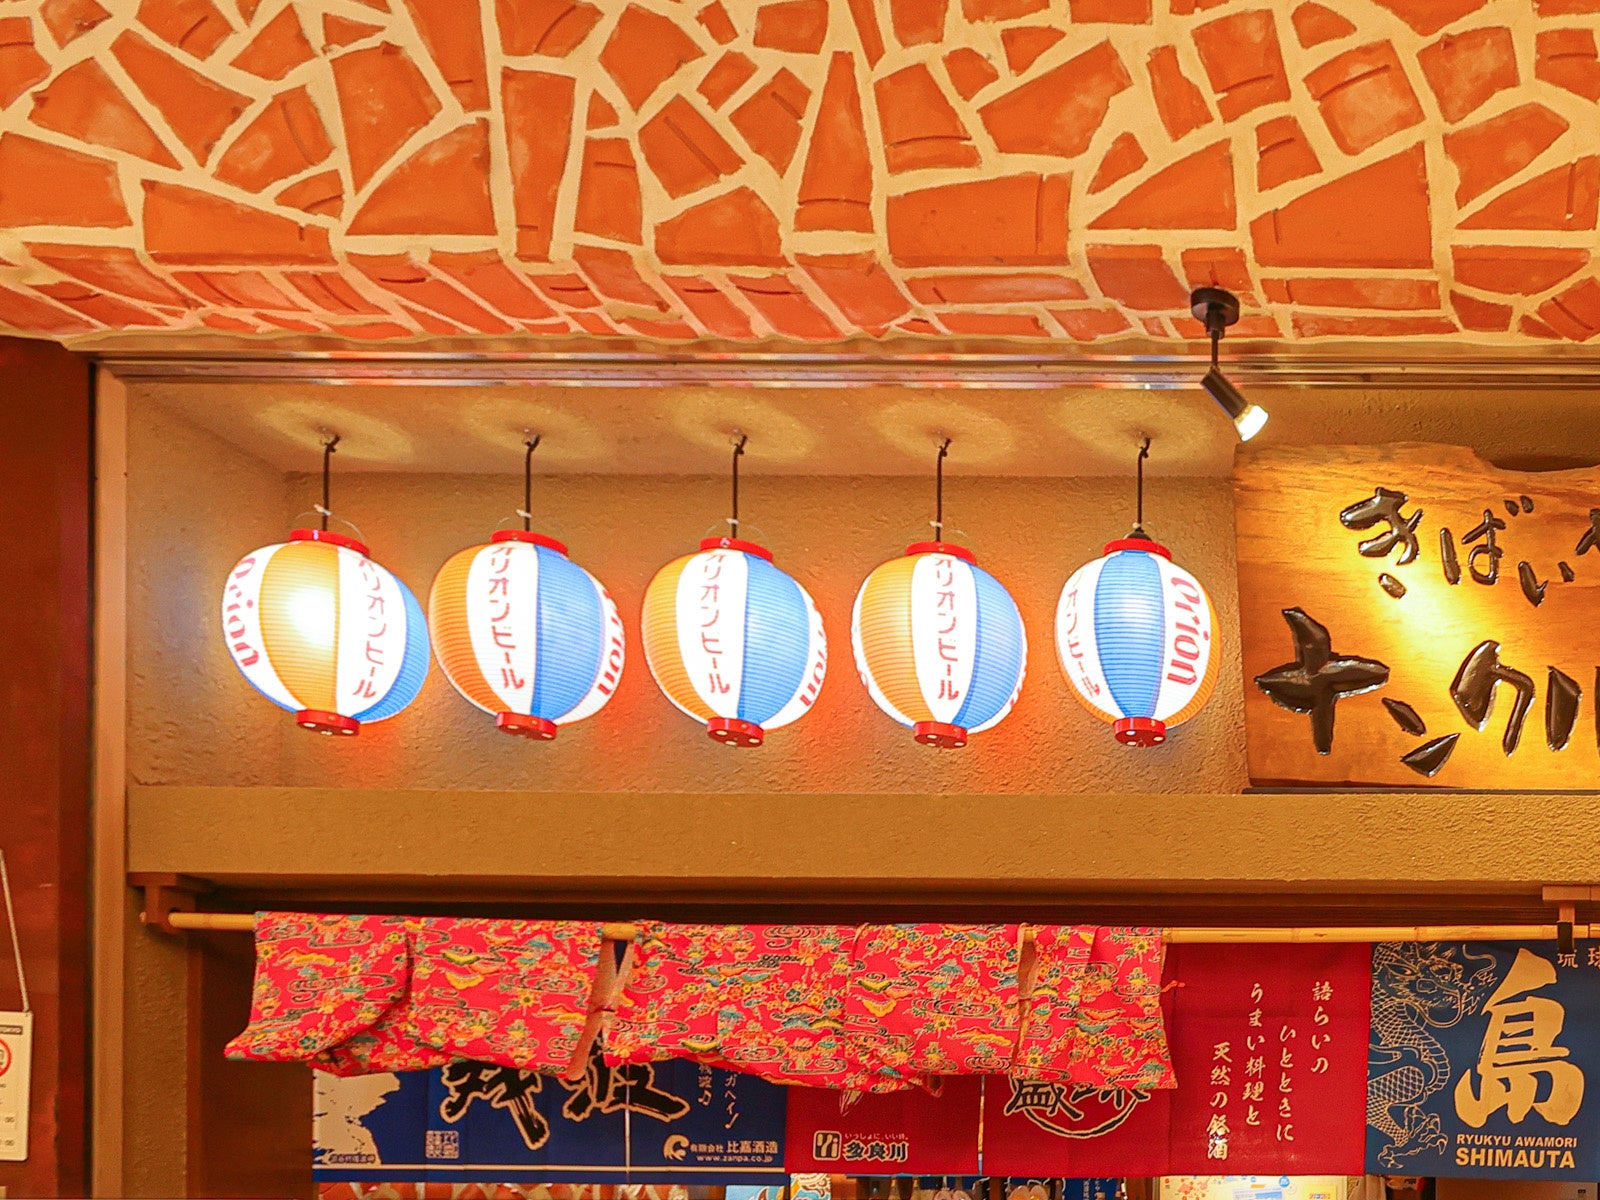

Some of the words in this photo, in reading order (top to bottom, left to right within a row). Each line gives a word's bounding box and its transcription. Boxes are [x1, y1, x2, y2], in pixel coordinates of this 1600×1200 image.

[1242, 981, 1267, 1127] うまい料理と
[1310, 981, 1335, 1074] 語らいの
[1454, 947, 1586, 1129] 島
[1206, 1041, 1234, 1160] 天然の銘酒
[1275, 1024, 1297, 1142] ひとときに
[696, 1154, 774, 1164] www.zanpa.co.jp
[726, 1140, 778, 1155] 比嘉酒造
[843, 1140, 910, 1163] 多良川
[1456, 1134, 1512, 1147] RYUKYU
[1514, 1135, 1578, 1149] AWAMORI
[1456, 1147, 1576, 1169] SHIMAUTA
